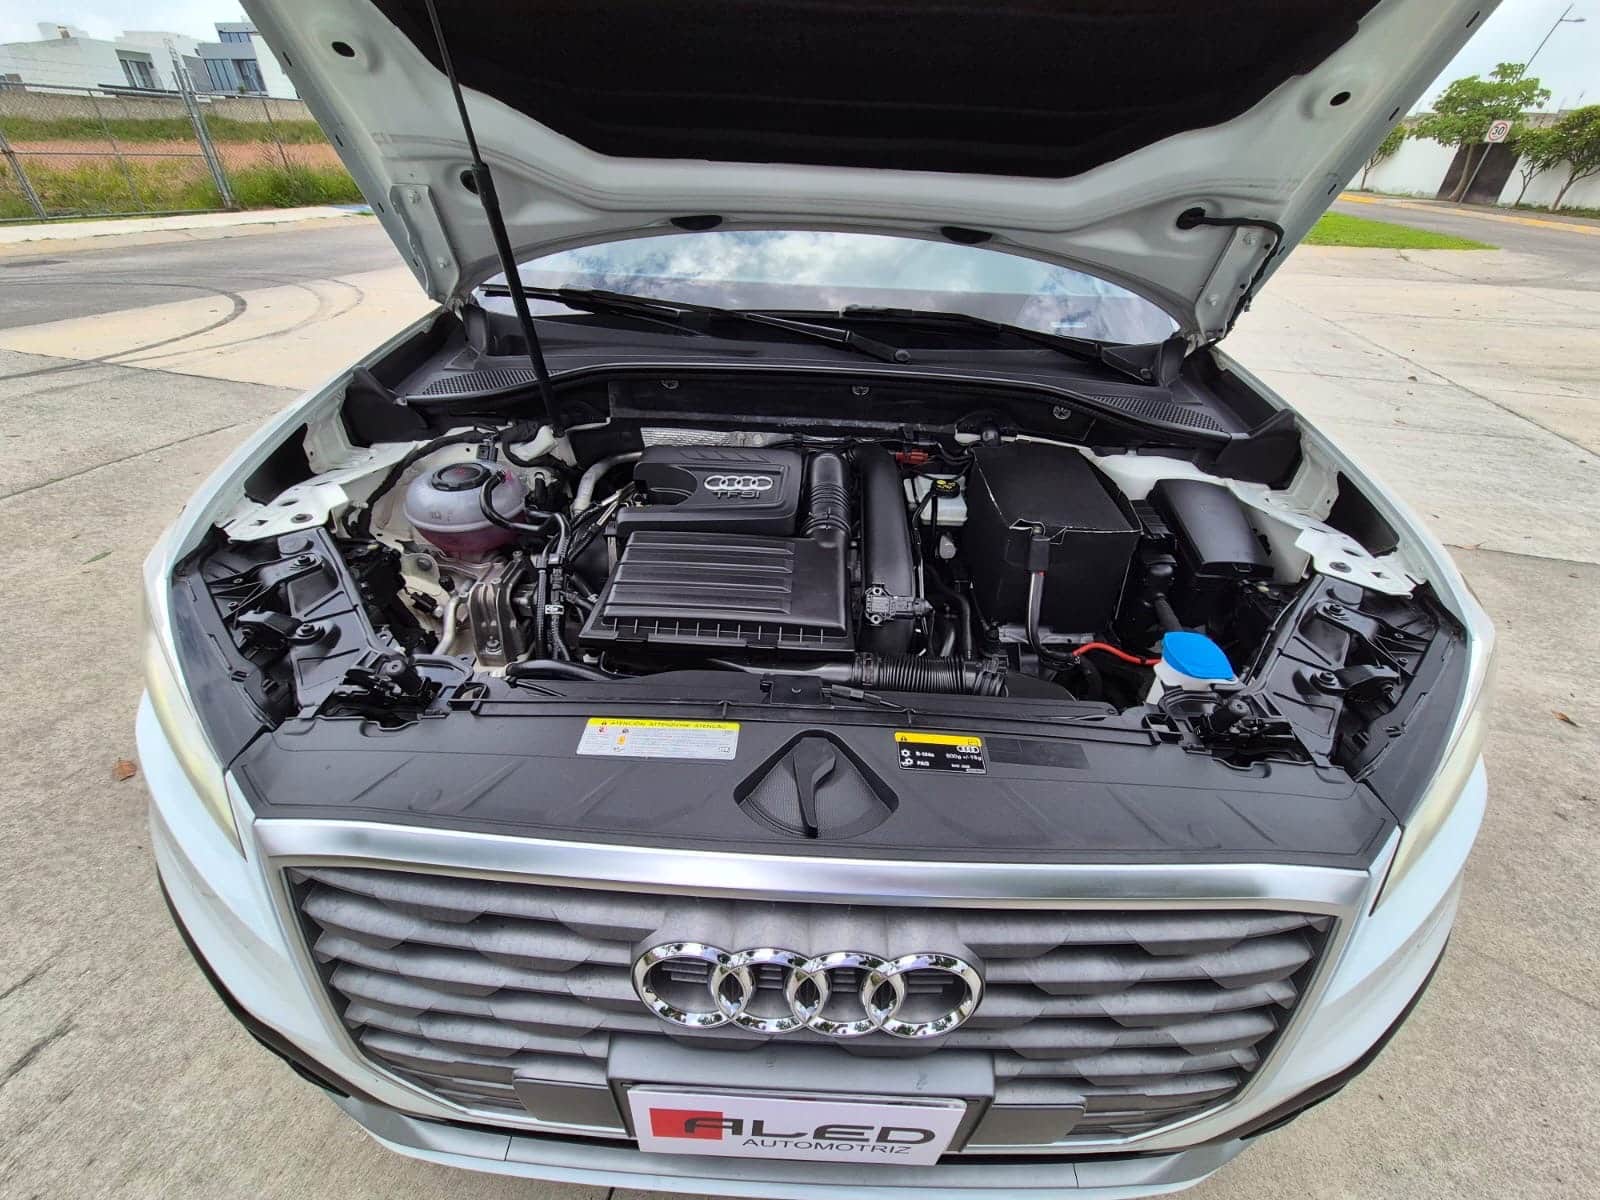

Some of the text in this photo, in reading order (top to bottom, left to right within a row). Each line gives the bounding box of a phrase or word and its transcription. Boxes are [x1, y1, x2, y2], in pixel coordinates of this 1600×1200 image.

[1491, 126, 1506, 136] 30
[713, 490, 760, 498] TFSI
[684, 1117, 935, 1145] ALED
[742, 1138, 911, 1155] AUTOMOTRIZ
